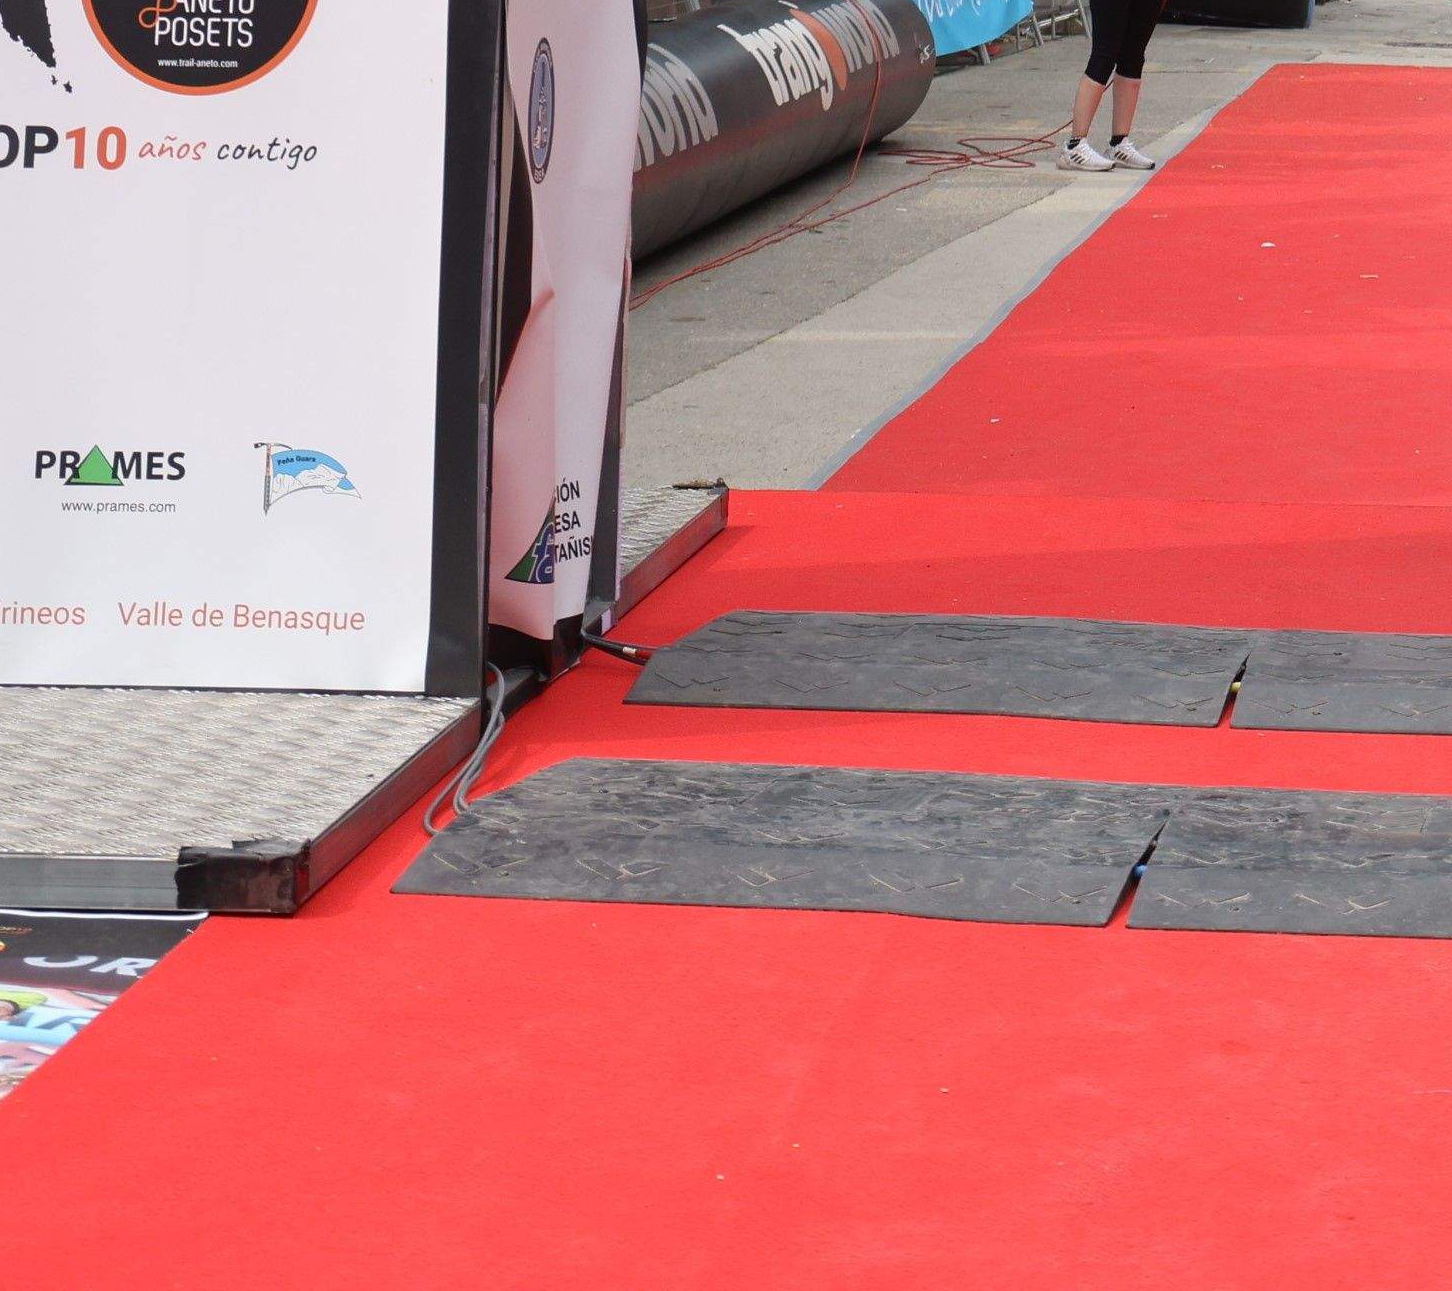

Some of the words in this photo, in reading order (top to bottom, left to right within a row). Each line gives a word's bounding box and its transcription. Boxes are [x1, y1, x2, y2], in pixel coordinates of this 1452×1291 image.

[154, 17, 253, 48] POSETS
[157, 58, 238, 69] www.trail-aneto.com
[138, 135, 206, 161] años
[216, 137, 317, 171] contigo
[61, 499, 176, 514] www.prames.com
[118, 601, 183, 627] Valle
[191, 603, 223, 628] de
[233, 603, 365, 636] Benasque
